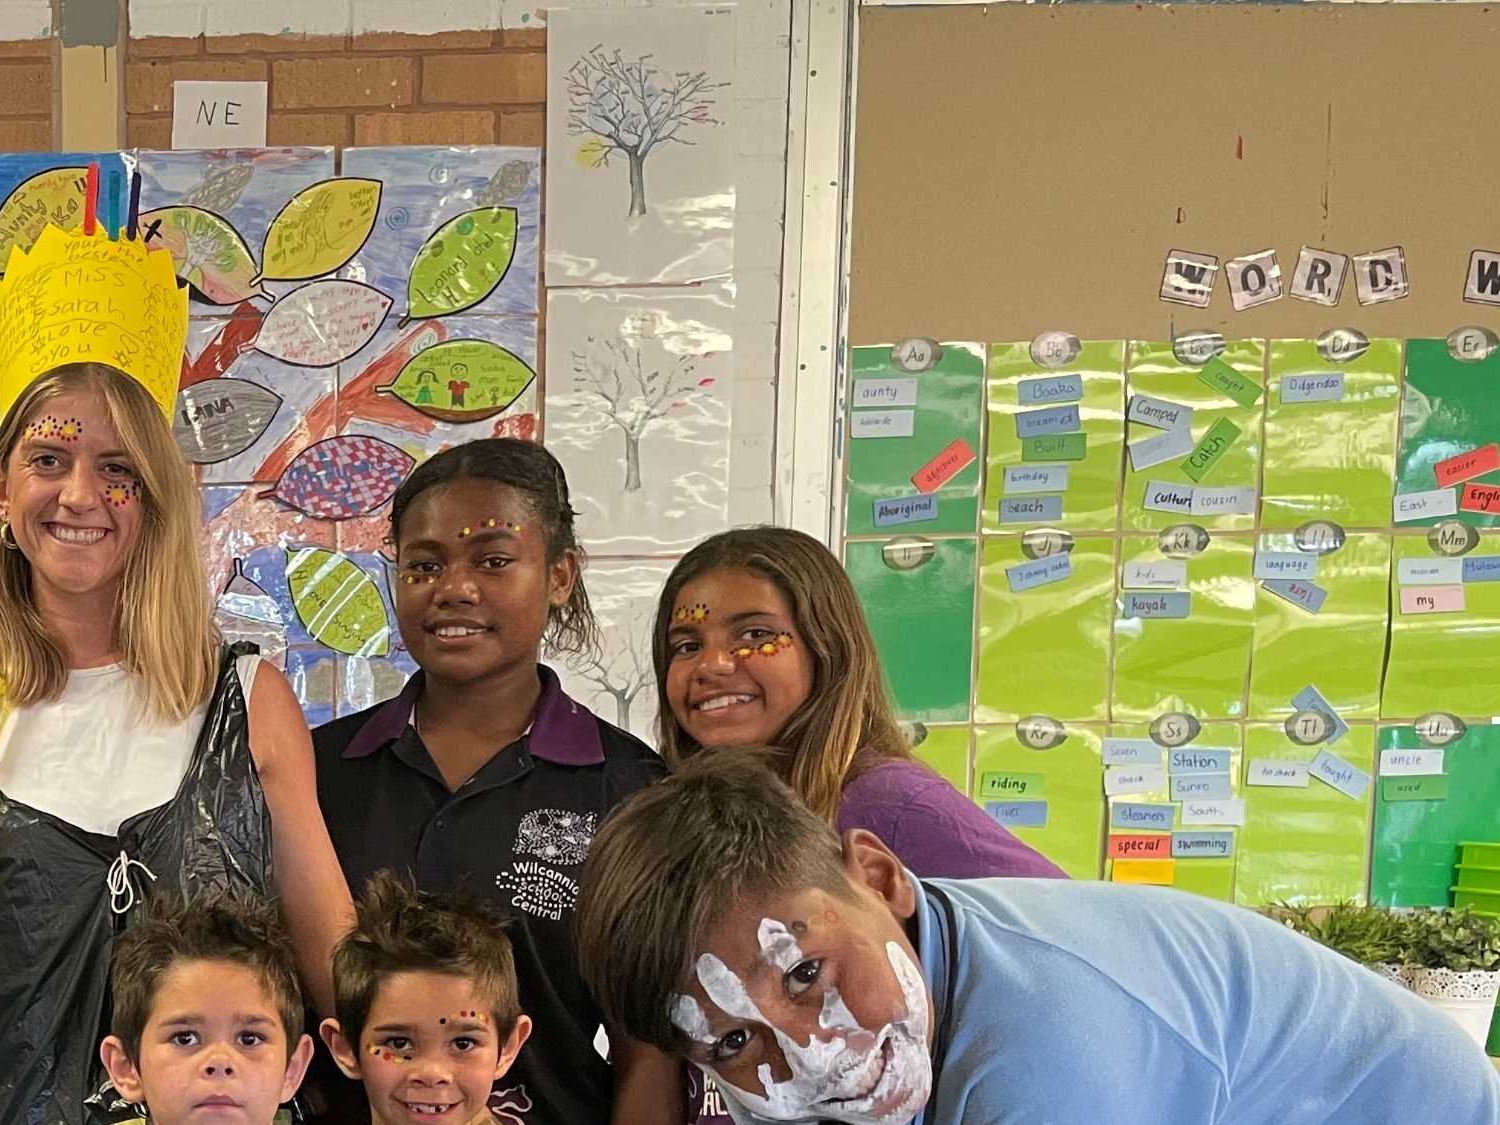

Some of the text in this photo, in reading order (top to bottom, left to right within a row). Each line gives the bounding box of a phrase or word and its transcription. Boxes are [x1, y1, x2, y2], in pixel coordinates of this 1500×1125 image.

[862, 387, 897, 400] aunty
[1136, 400, 1179, 424] Camped
[1190, 437, 1225, 468] Catch
[1008, 499, 1043, 513] beach
[1201, 495, 1237, 506] cousin
[1400, 499, 1428, 512] East
[879, 500, 931, 518] Aboriginal
[1441, 530, 1465, 546] Mm
[1132, 598, 1167, 614] kayak
[1416, 596, 1435, 609] my
[1173, 753, 1218, 768] Station
[1390, 755, 1422, 765] uncle
[991, 777, 1027, 793] riding
[1118, 839, 1160, 854] special
[1178, 837, 1227, 853] swimming
[513, 862, 579, 896] Wilcannia
[522, 881, 563, 903] SCHOOL
[512, 896, 562, 920] Central
